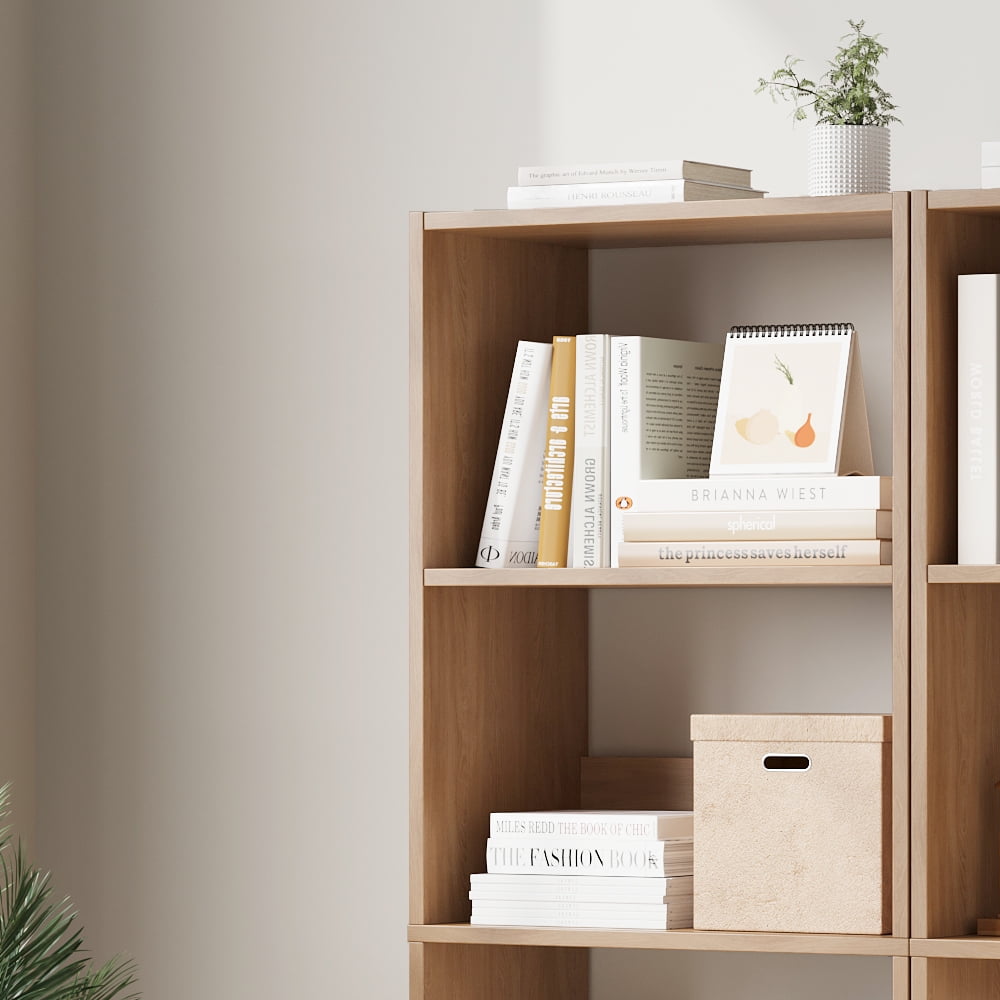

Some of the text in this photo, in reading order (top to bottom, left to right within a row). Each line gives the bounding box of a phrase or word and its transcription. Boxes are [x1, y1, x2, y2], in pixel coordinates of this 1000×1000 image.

[691, 487, 827, 502] BRIANNA WIEST
[727, 514, 776, 535] spherical
[658, 545, 848, 564] the princess saves herself
[496, 820, 650, 837] MILES REDD THE BOOK OF CHIC
[490, 847, 526, 867] THE
[530, 848, 604, 867] FASHION
